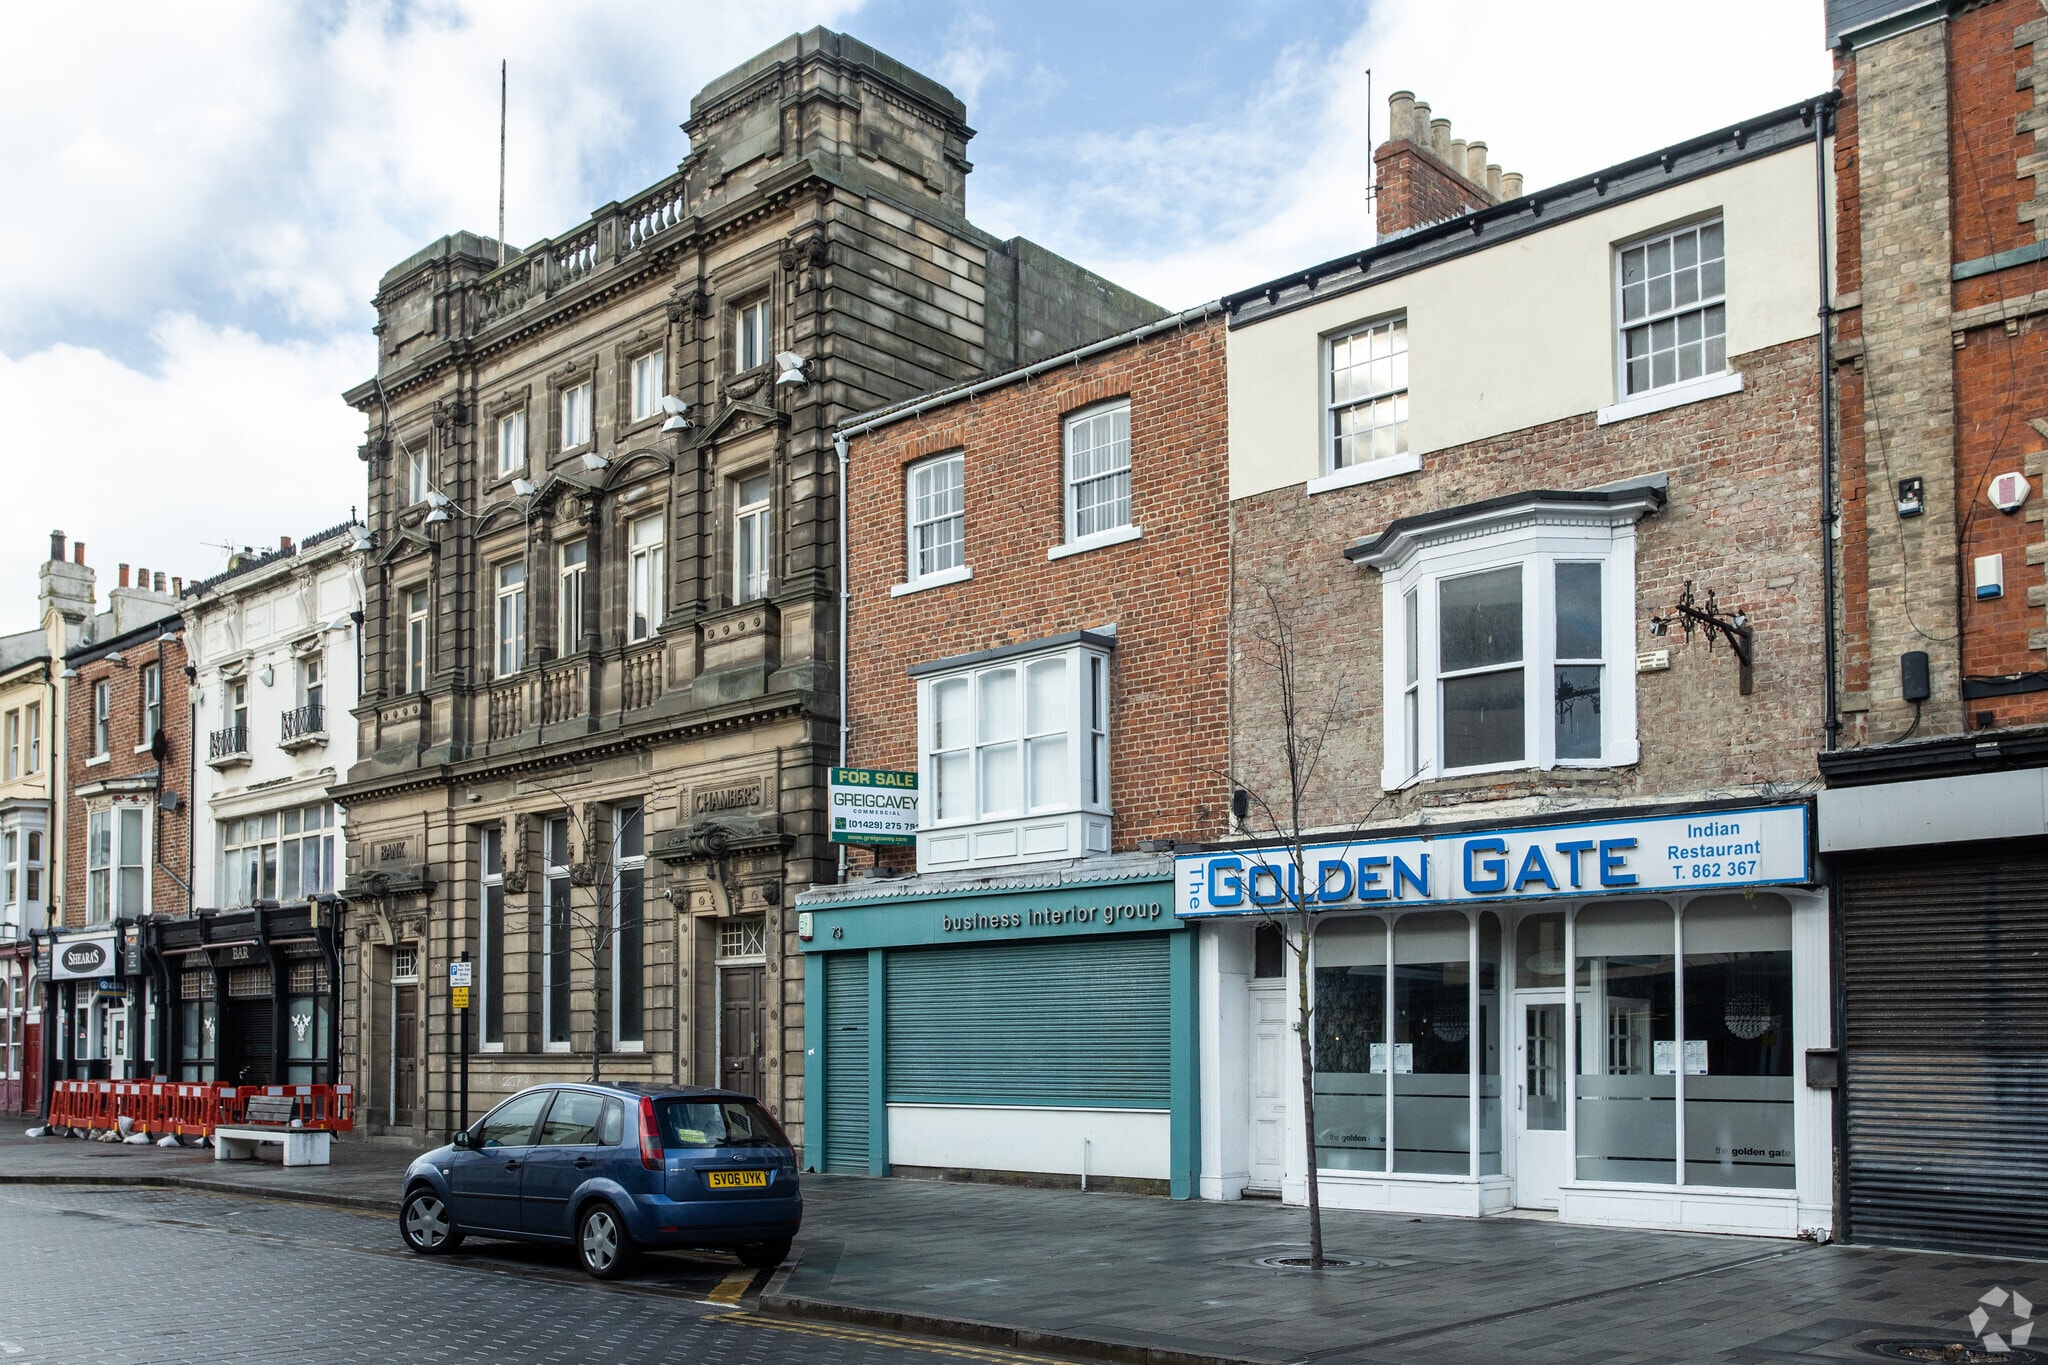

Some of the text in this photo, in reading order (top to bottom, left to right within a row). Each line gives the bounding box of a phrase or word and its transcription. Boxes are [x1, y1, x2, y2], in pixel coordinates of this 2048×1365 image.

[839, 771, 914, 787] FOR SALE
[696, 784, 760, 813] CHAMBERS
[834, 793, 918, 810] GREIGCAVEY
[848, 819, 883, 830] (01429)
[885, 822, 902, 830] 275
[1687, 822, 1740, 839] Indian
[381, 841, 406, 860] BANK
[1667, 840, 1761, 861] Restaurant
[1207, 837, 1640, 908] GOLDEN GATE
[1672, 860, 1757, 880] T. 862 367
[1189, 863, 1205, 910] The
[942, 901, 1161, 932] business interior group
[831, 926, 842, 939] 73
[68, 949, 99, 966] SHEARA'S
[232, 946, 249, 960] BAR
[1342, 1134, 1367, 1143] golden
[1715, 1146, 1792, 1158] the golden gate
[713, 1172, 762, 1185] SV06 UYK
